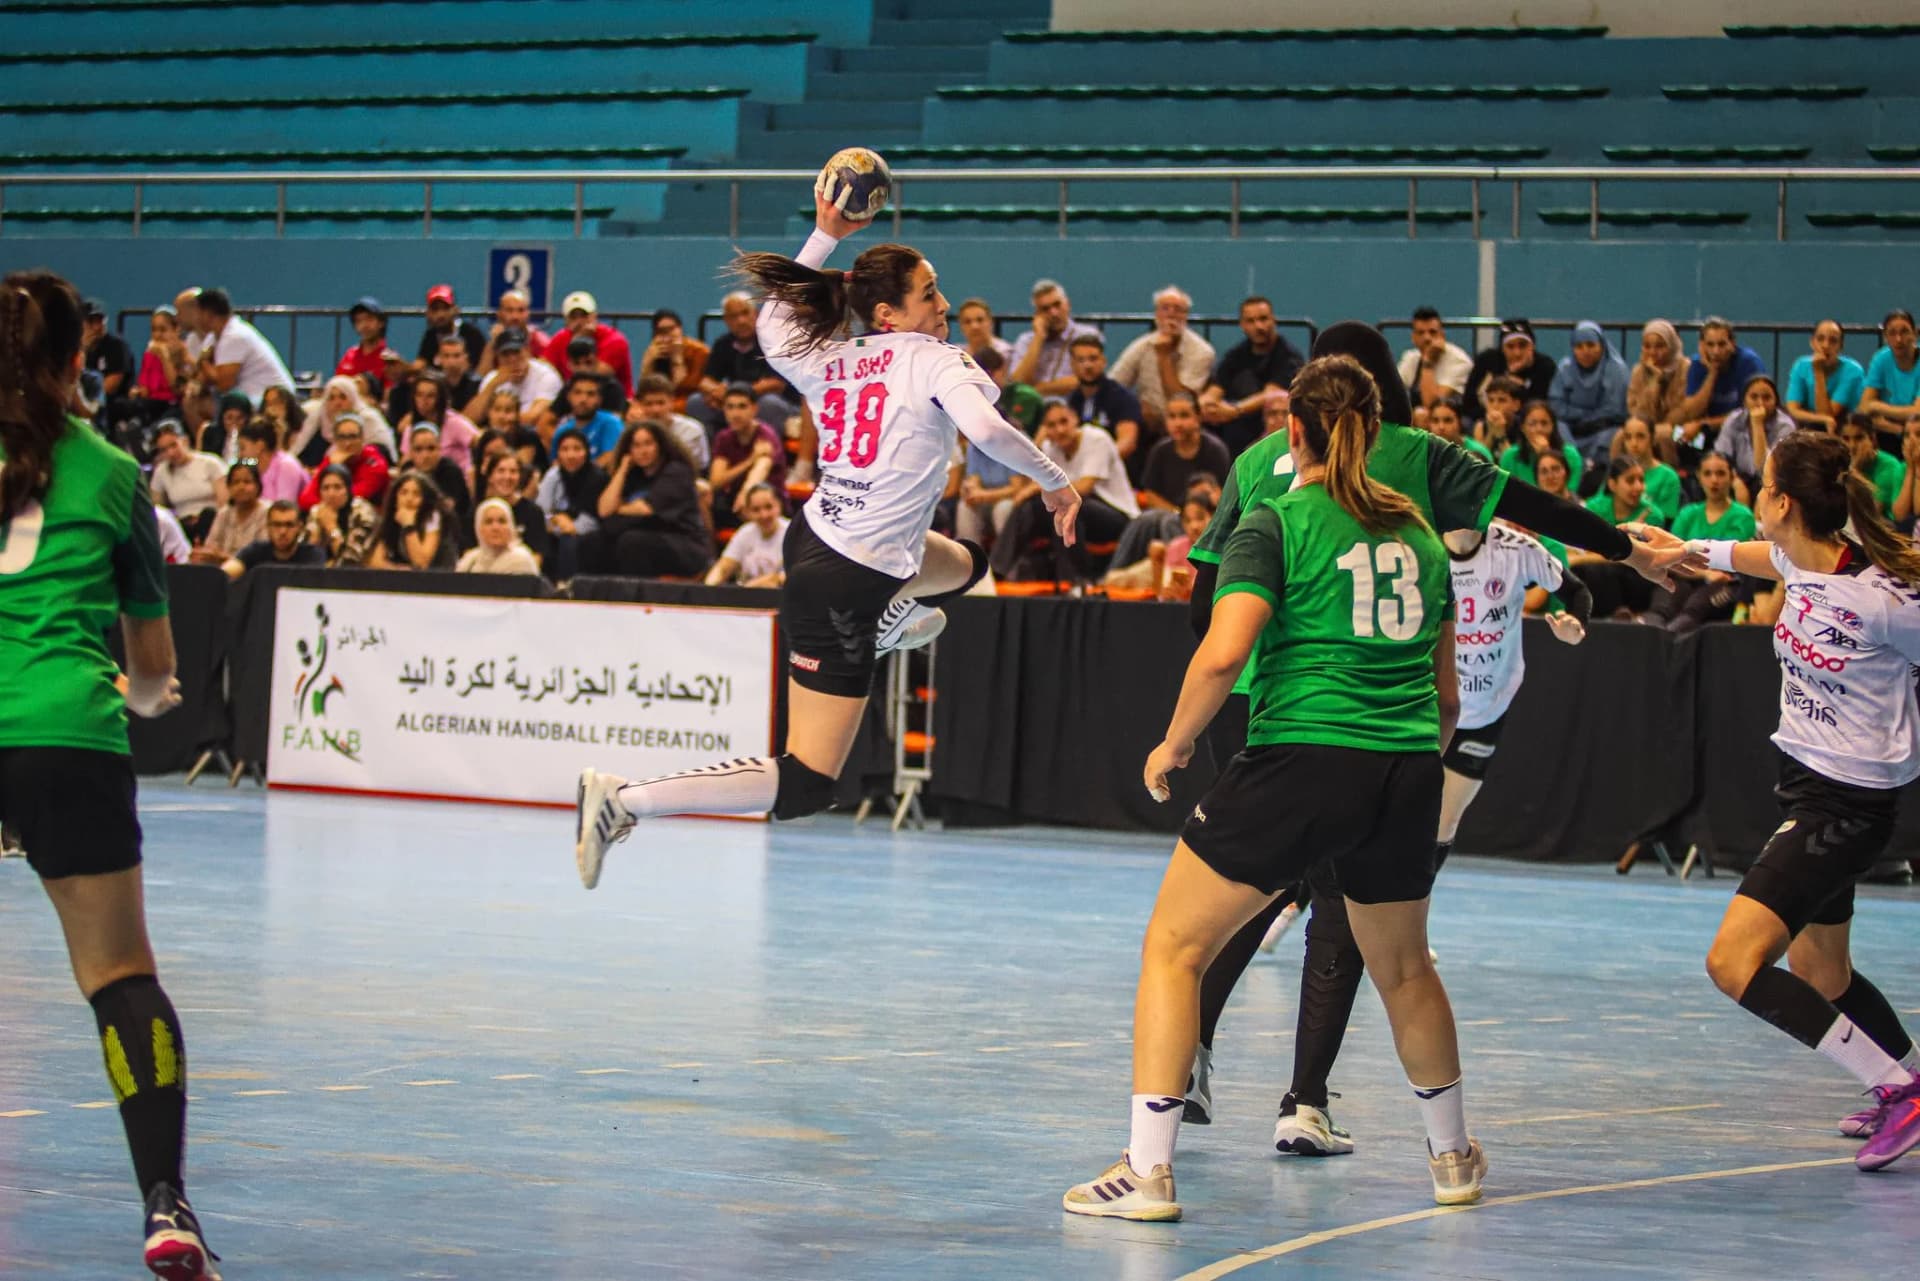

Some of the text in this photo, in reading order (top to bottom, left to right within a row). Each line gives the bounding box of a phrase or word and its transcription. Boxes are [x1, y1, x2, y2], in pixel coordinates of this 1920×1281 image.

[1336, 541, 1425, 641] 13
[1455, 629, 1504, 645] edoo
[1773, 622, 1845, 672] oredoo
[397, 655, 435, 694] اليد
[444, 657, 495, 698] لكرة
[504, 654, 616, 705] الجزائرية
[396, 713, 731, 752] ALGERIAN HANDBALL FEDERATION
